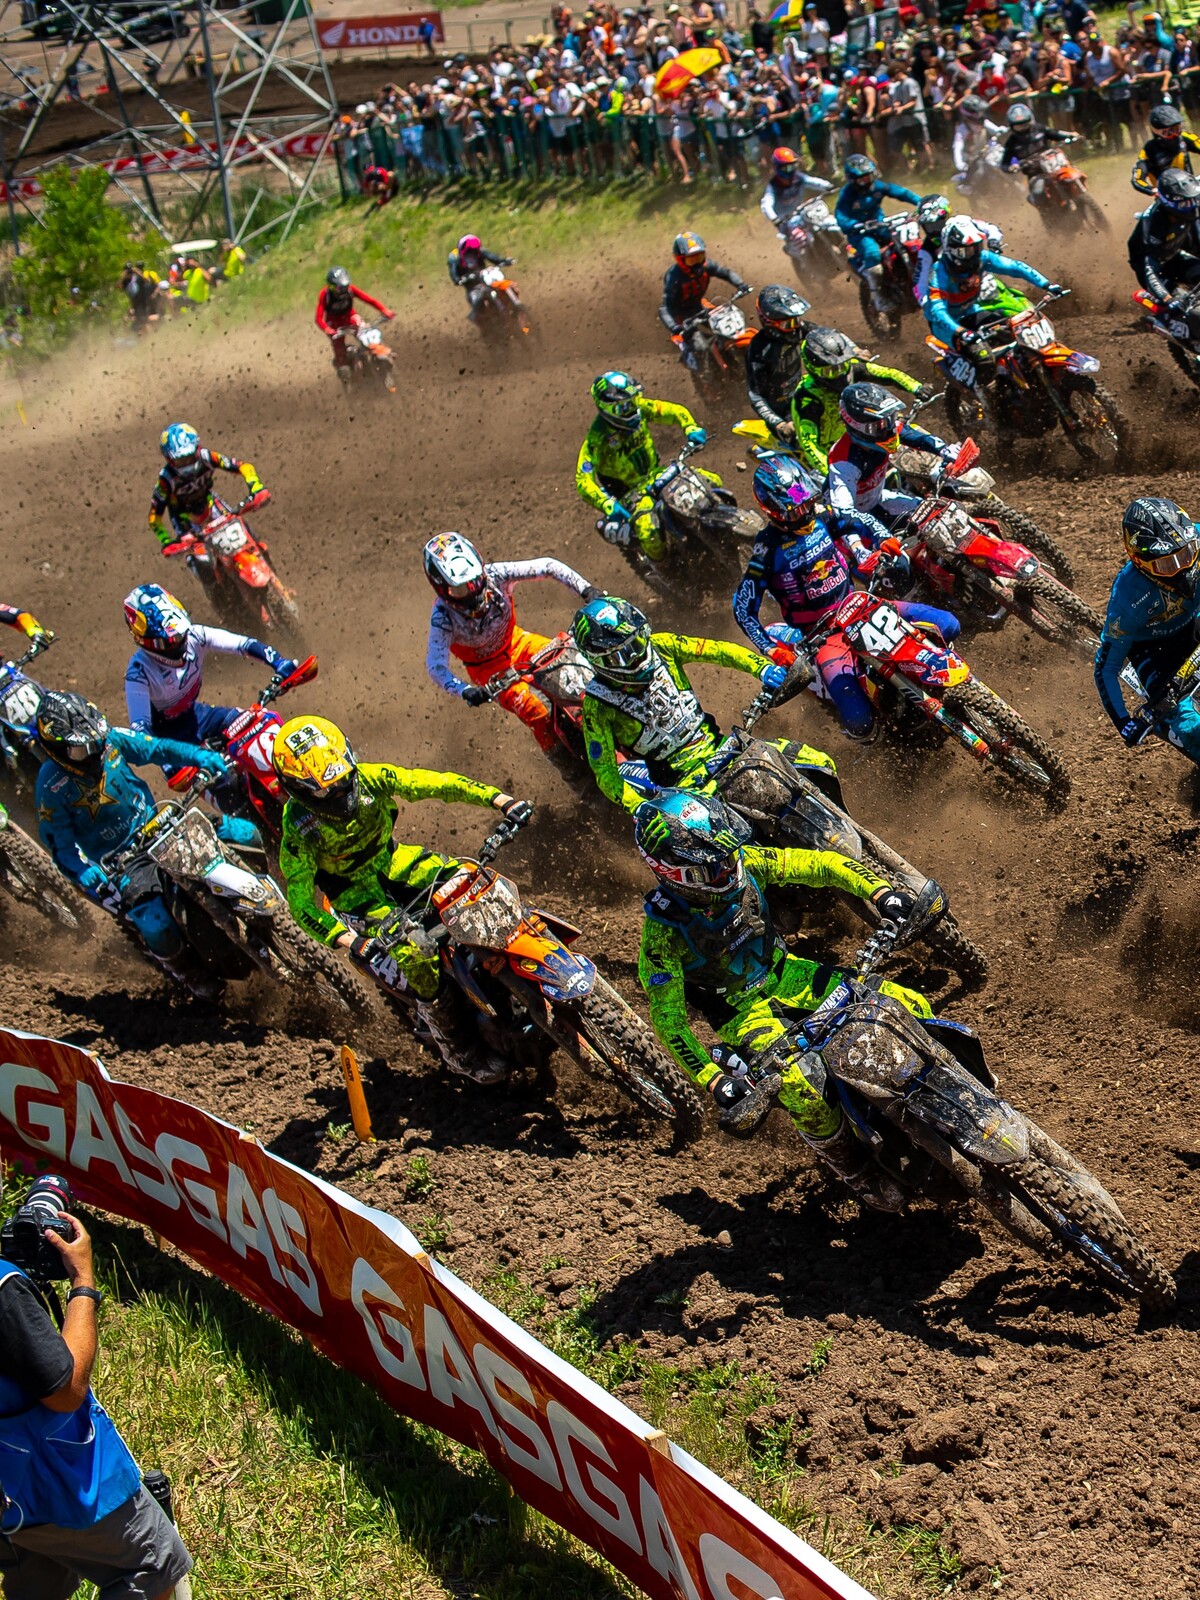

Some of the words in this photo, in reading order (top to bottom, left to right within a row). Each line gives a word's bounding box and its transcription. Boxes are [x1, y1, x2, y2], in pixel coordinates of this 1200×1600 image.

[348, 24, 441, 45] HOND
[1021, 320, 1056, 349] 604
[604, 521, 631, 545] 64
[790, 535, 832, 569] GASGAS
[860, 605, 904, 656] 42
[5, 683, 40, 725] 48
[300, 911, 331, 938] THOR
[670, 1035, 706, 1073] THOR
[0, 1062, 323, 1316] GASGAS
